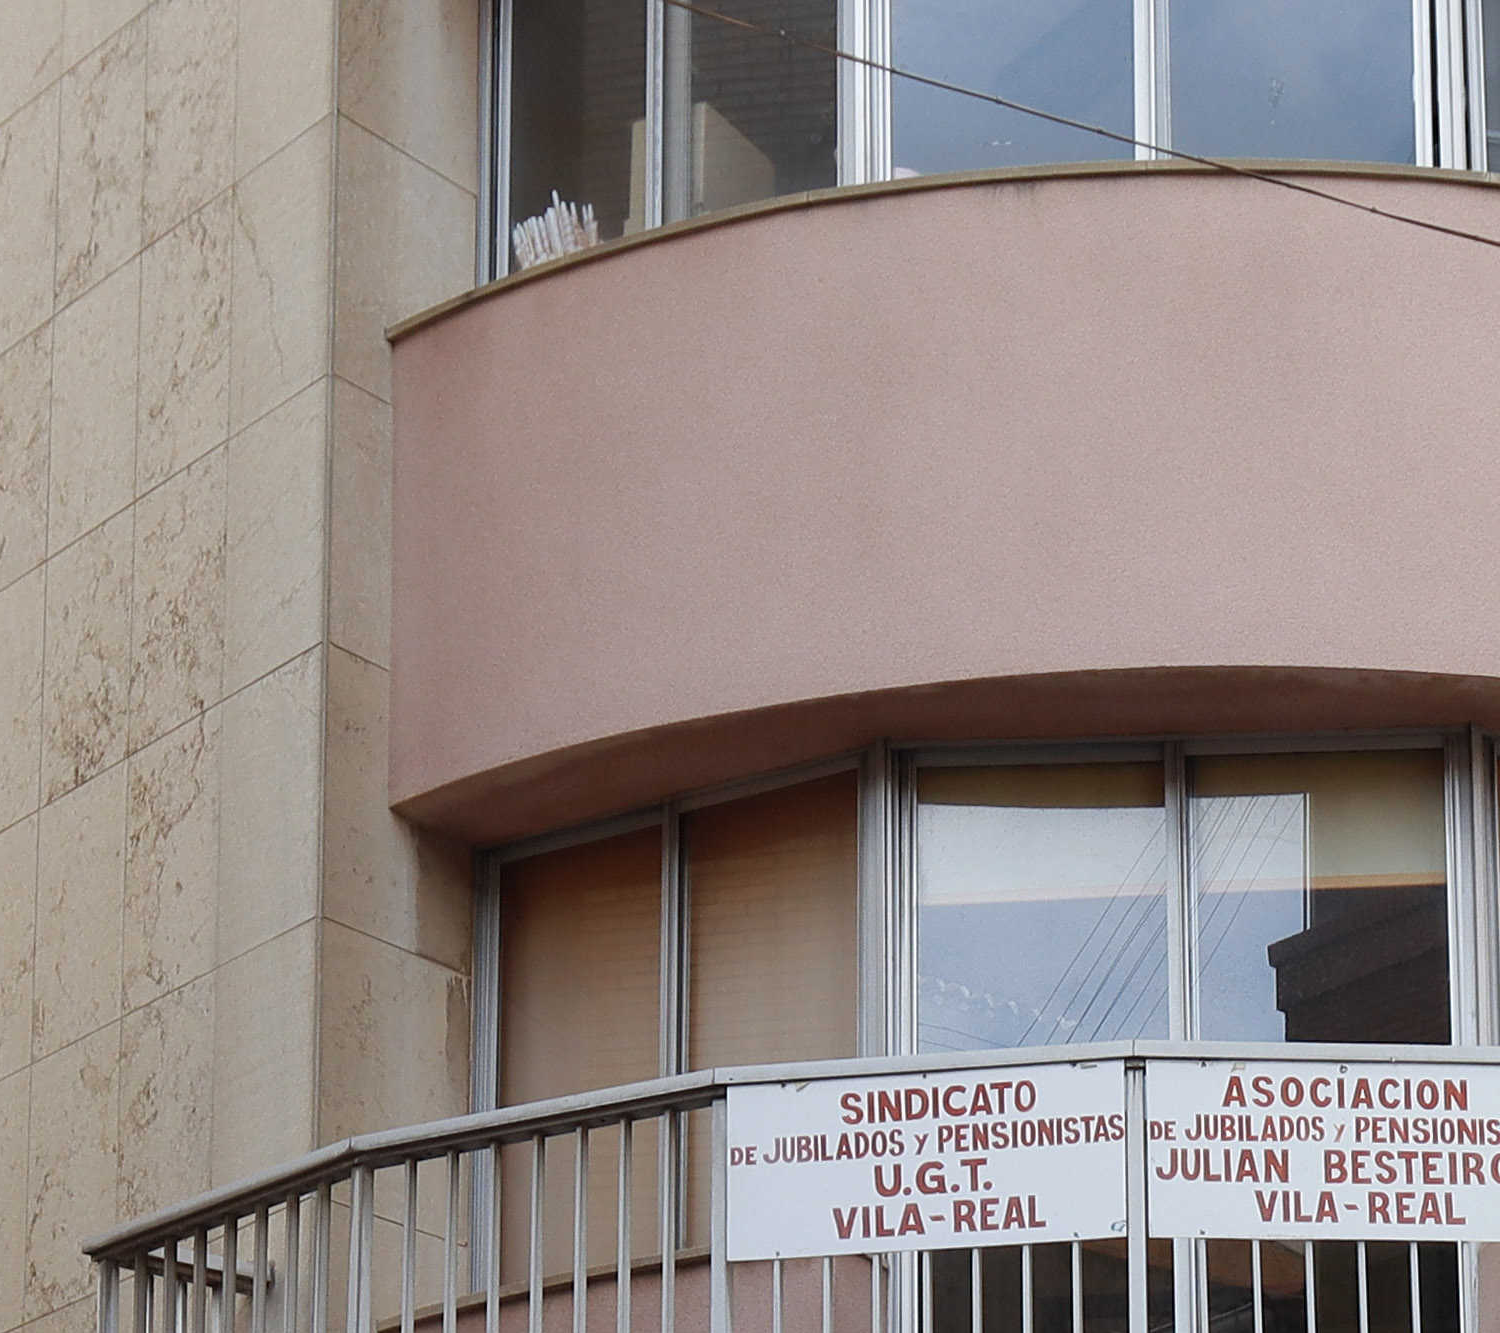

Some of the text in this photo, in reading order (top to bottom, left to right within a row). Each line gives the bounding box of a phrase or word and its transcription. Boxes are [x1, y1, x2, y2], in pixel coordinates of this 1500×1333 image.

[840, 1079, 1036, 1125] SINDICATO
[1222, 1076, 1468, 1111] ASOCIACION
[730, 1145, 757, 1166] DE
[764, 1127, 904, 1164] JUBILADOS
[938, 1114, 1124, 1153] PENSIONISTAS
[1149, 1120, 1176, 1141] DE
[1185, 1113, 1325, 1142] JUBILADOS
[874, 1157, 992, 1197] U.G.T.
[1156, 1148, 1290, 1184] JULIAN
